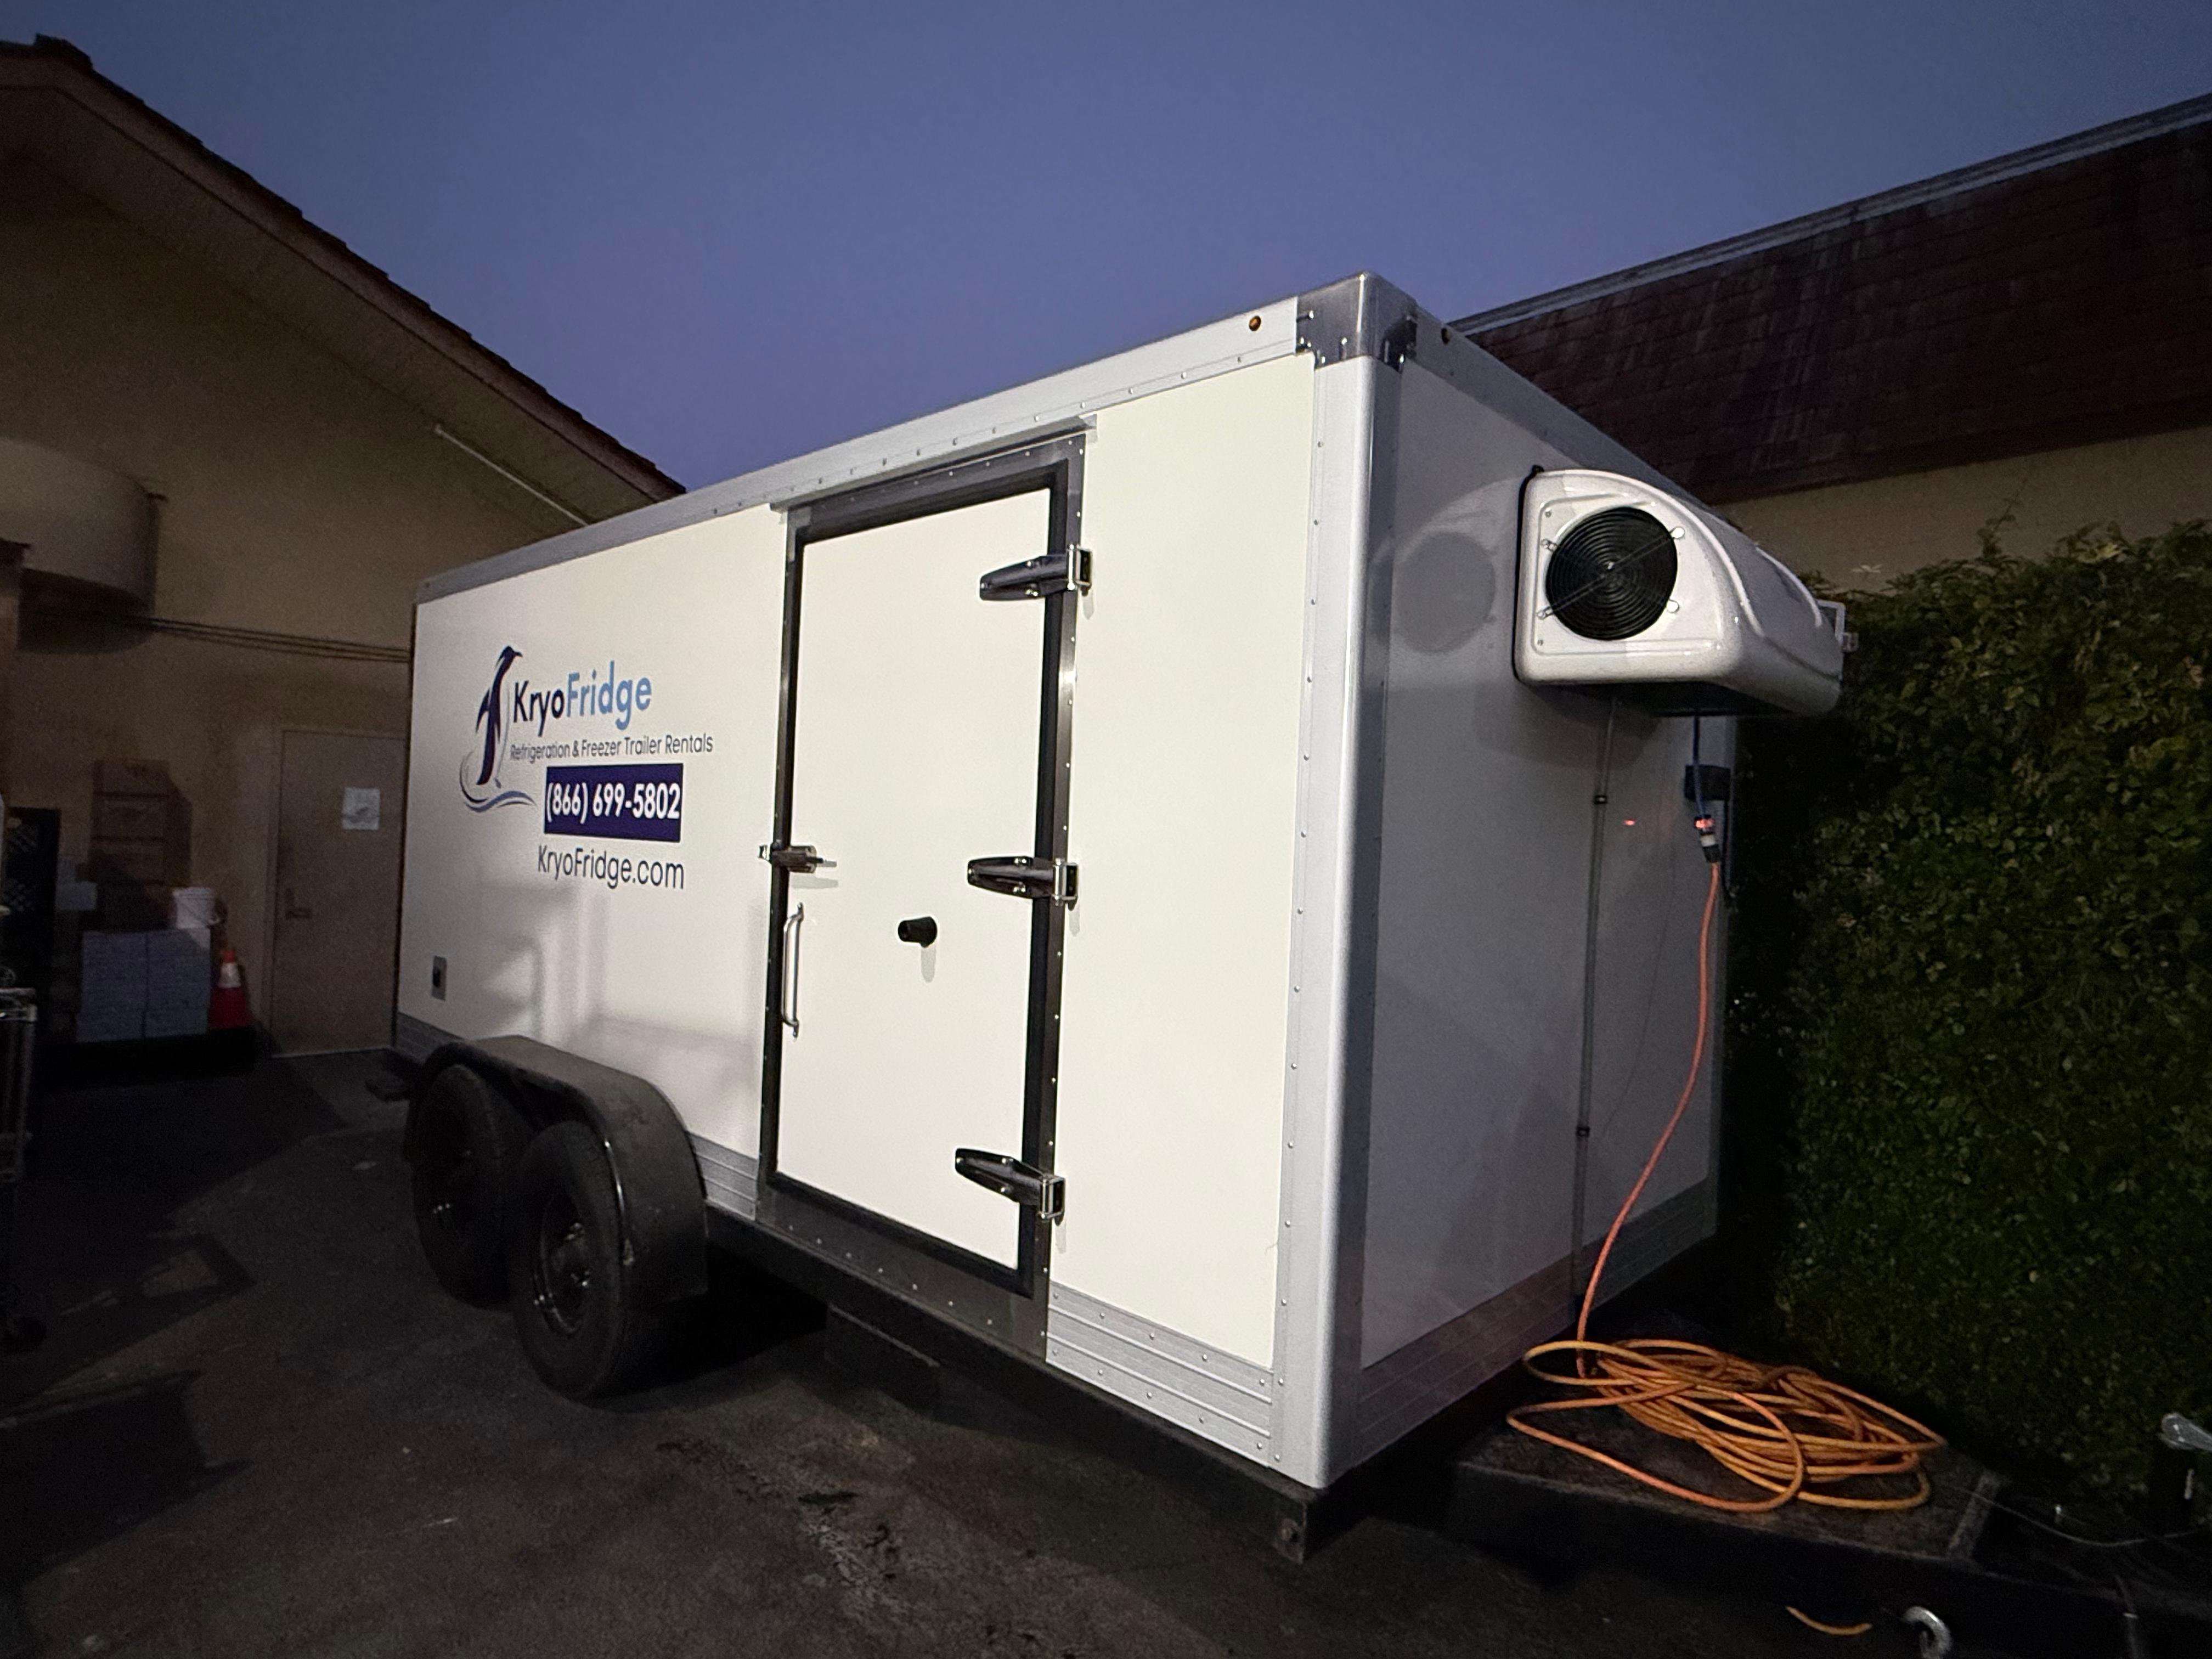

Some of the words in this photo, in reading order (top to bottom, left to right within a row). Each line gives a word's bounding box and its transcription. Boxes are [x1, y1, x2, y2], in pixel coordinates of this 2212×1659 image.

[513, 661, 652, 737] KryoFridge
[511, 740, 571, 764] Refrigeration
[572, 741, 580, 758] &
[582, 738, 621, 758] Freezer
[624, 736, 662, 755] Trailer
[665, 733, 713, 753] Rentals
[547, 782, 588, 823] (866)
[592, 782, 680, 819] 699-5802
[538, 845, 684, 889] KryoFridge.com
